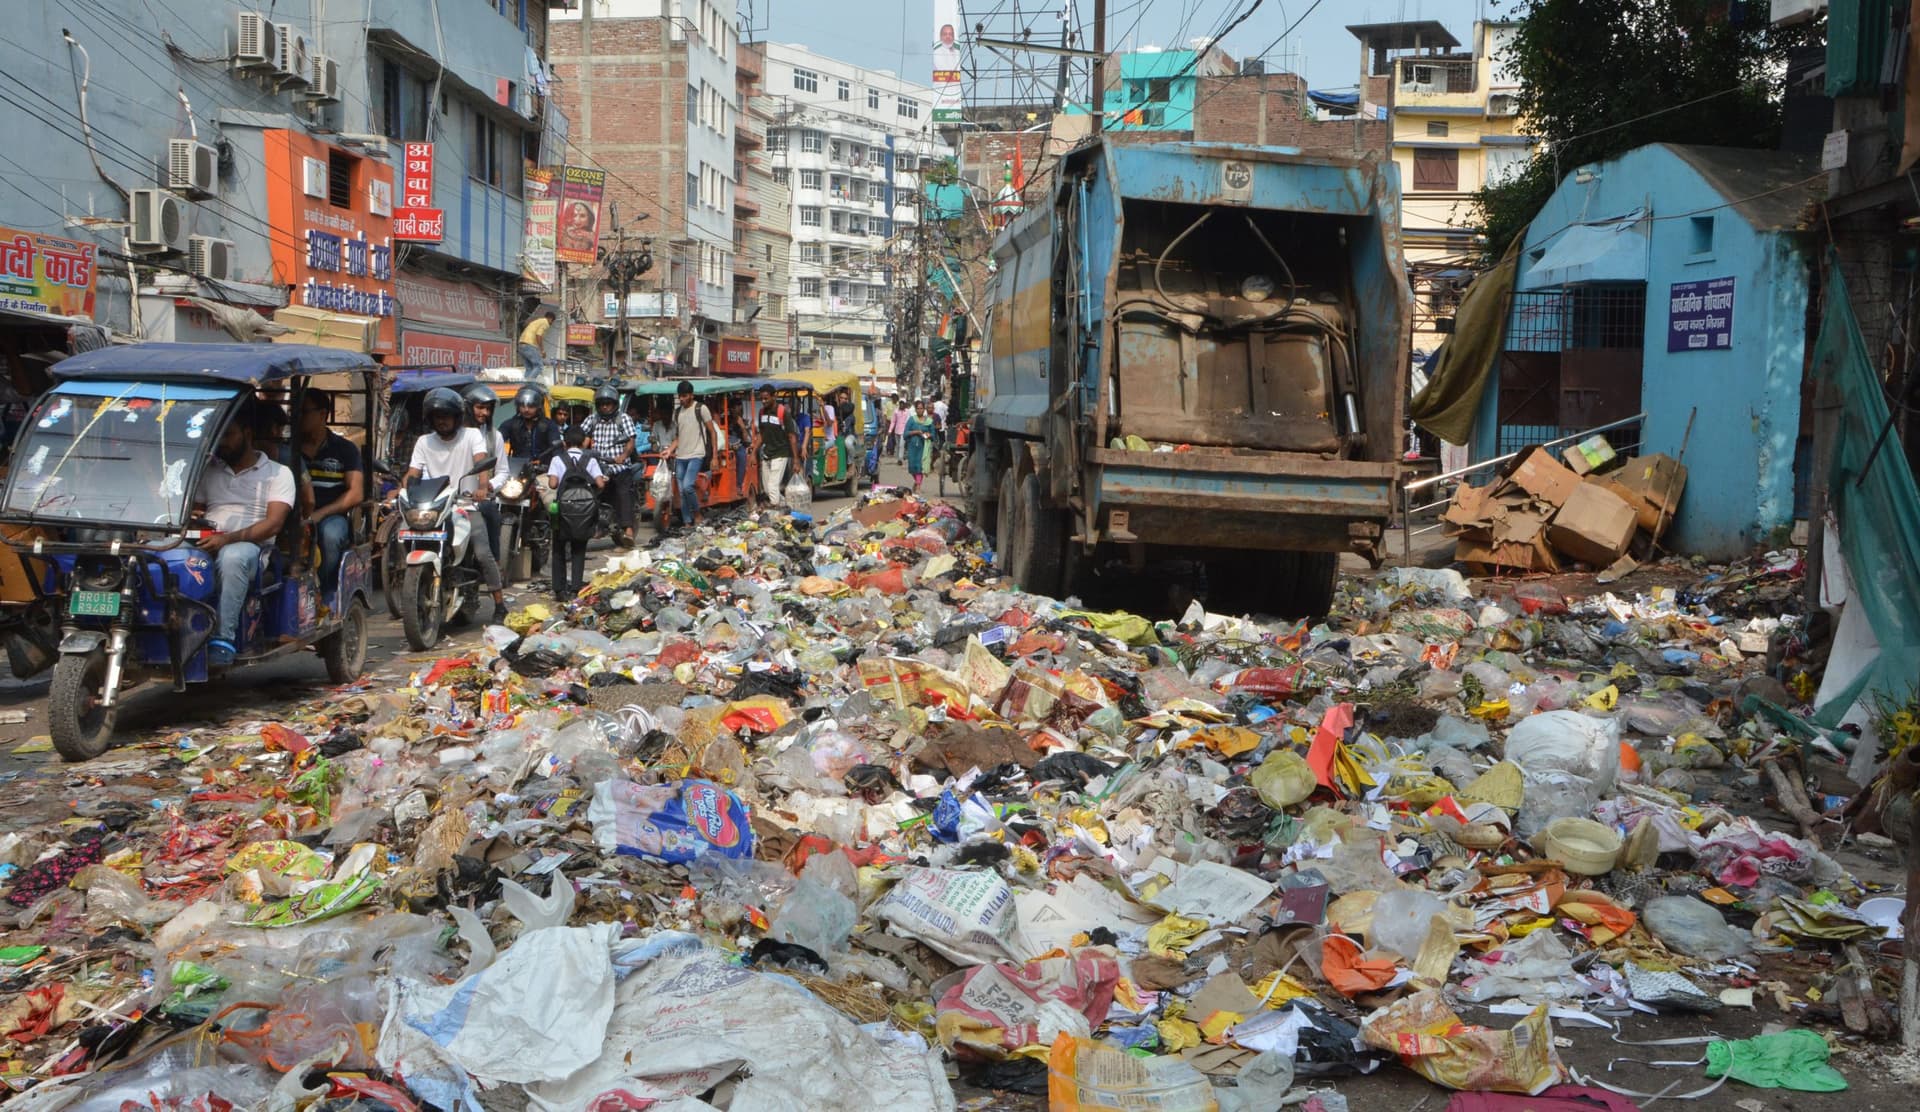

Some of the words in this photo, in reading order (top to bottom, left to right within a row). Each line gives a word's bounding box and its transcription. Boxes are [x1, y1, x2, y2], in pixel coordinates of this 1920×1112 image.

[566, 167, 604, 181] OZONE
[393, 212, 416, 235] शादी
[418, 213, 442, 236] कार्ड
[0, 235, 37, 279] ादी
[43, 247, 92, 286] कार्ड
[21, 301, 48, 313] निर्माता
[1671, 293, 1703, 313] सार्वजनिक
[1704, 291, 1732, 311] शौचालय
[1705, 314, 1726, 330] निगम
[407, 346, 455, 367] अग्रवाल
[458, 343, 483, 368] शादी
[486, 346, 509, 368] कार्ड
[727, 350, 737, 362] VEG
